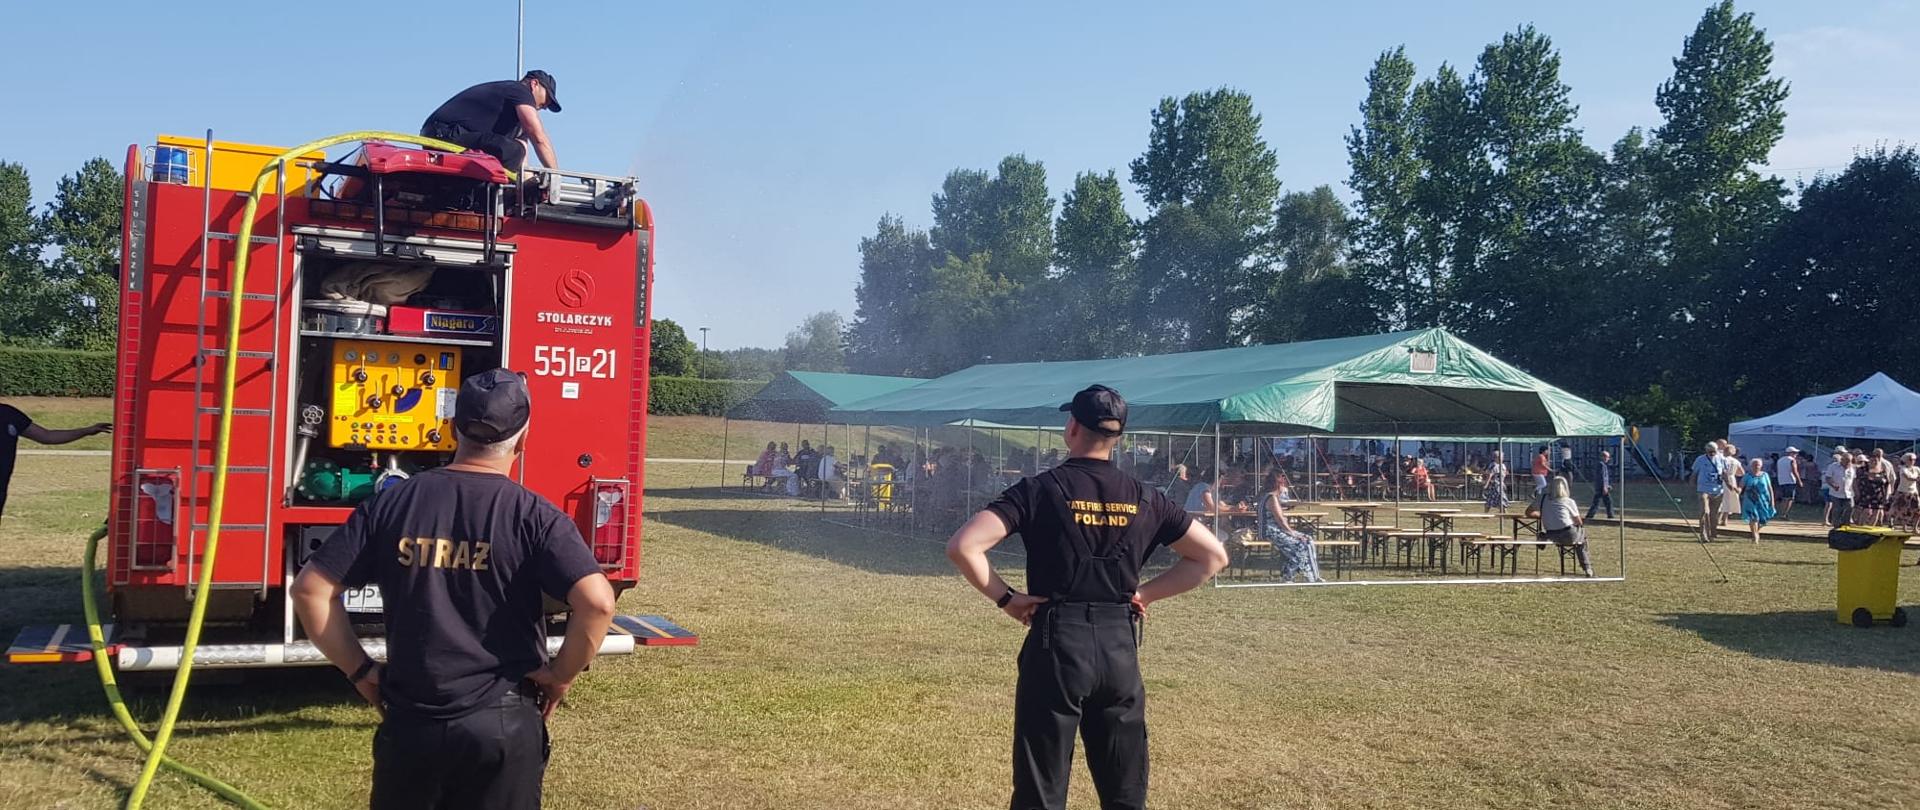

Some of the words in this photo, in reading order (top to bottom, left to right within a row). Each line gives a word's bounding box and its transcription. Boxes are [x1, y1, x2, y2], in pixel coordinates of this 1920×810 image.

[431, 316, 475, 330] Niagara
[537, 312, 613, 327] STOLARCZYK
[534, 345, 575, 378] 551
[591, 348, 616, 379] 21
[1086, 501, 1105, 512] FIRE
[1075, 513, 1128, 526] POLAND
